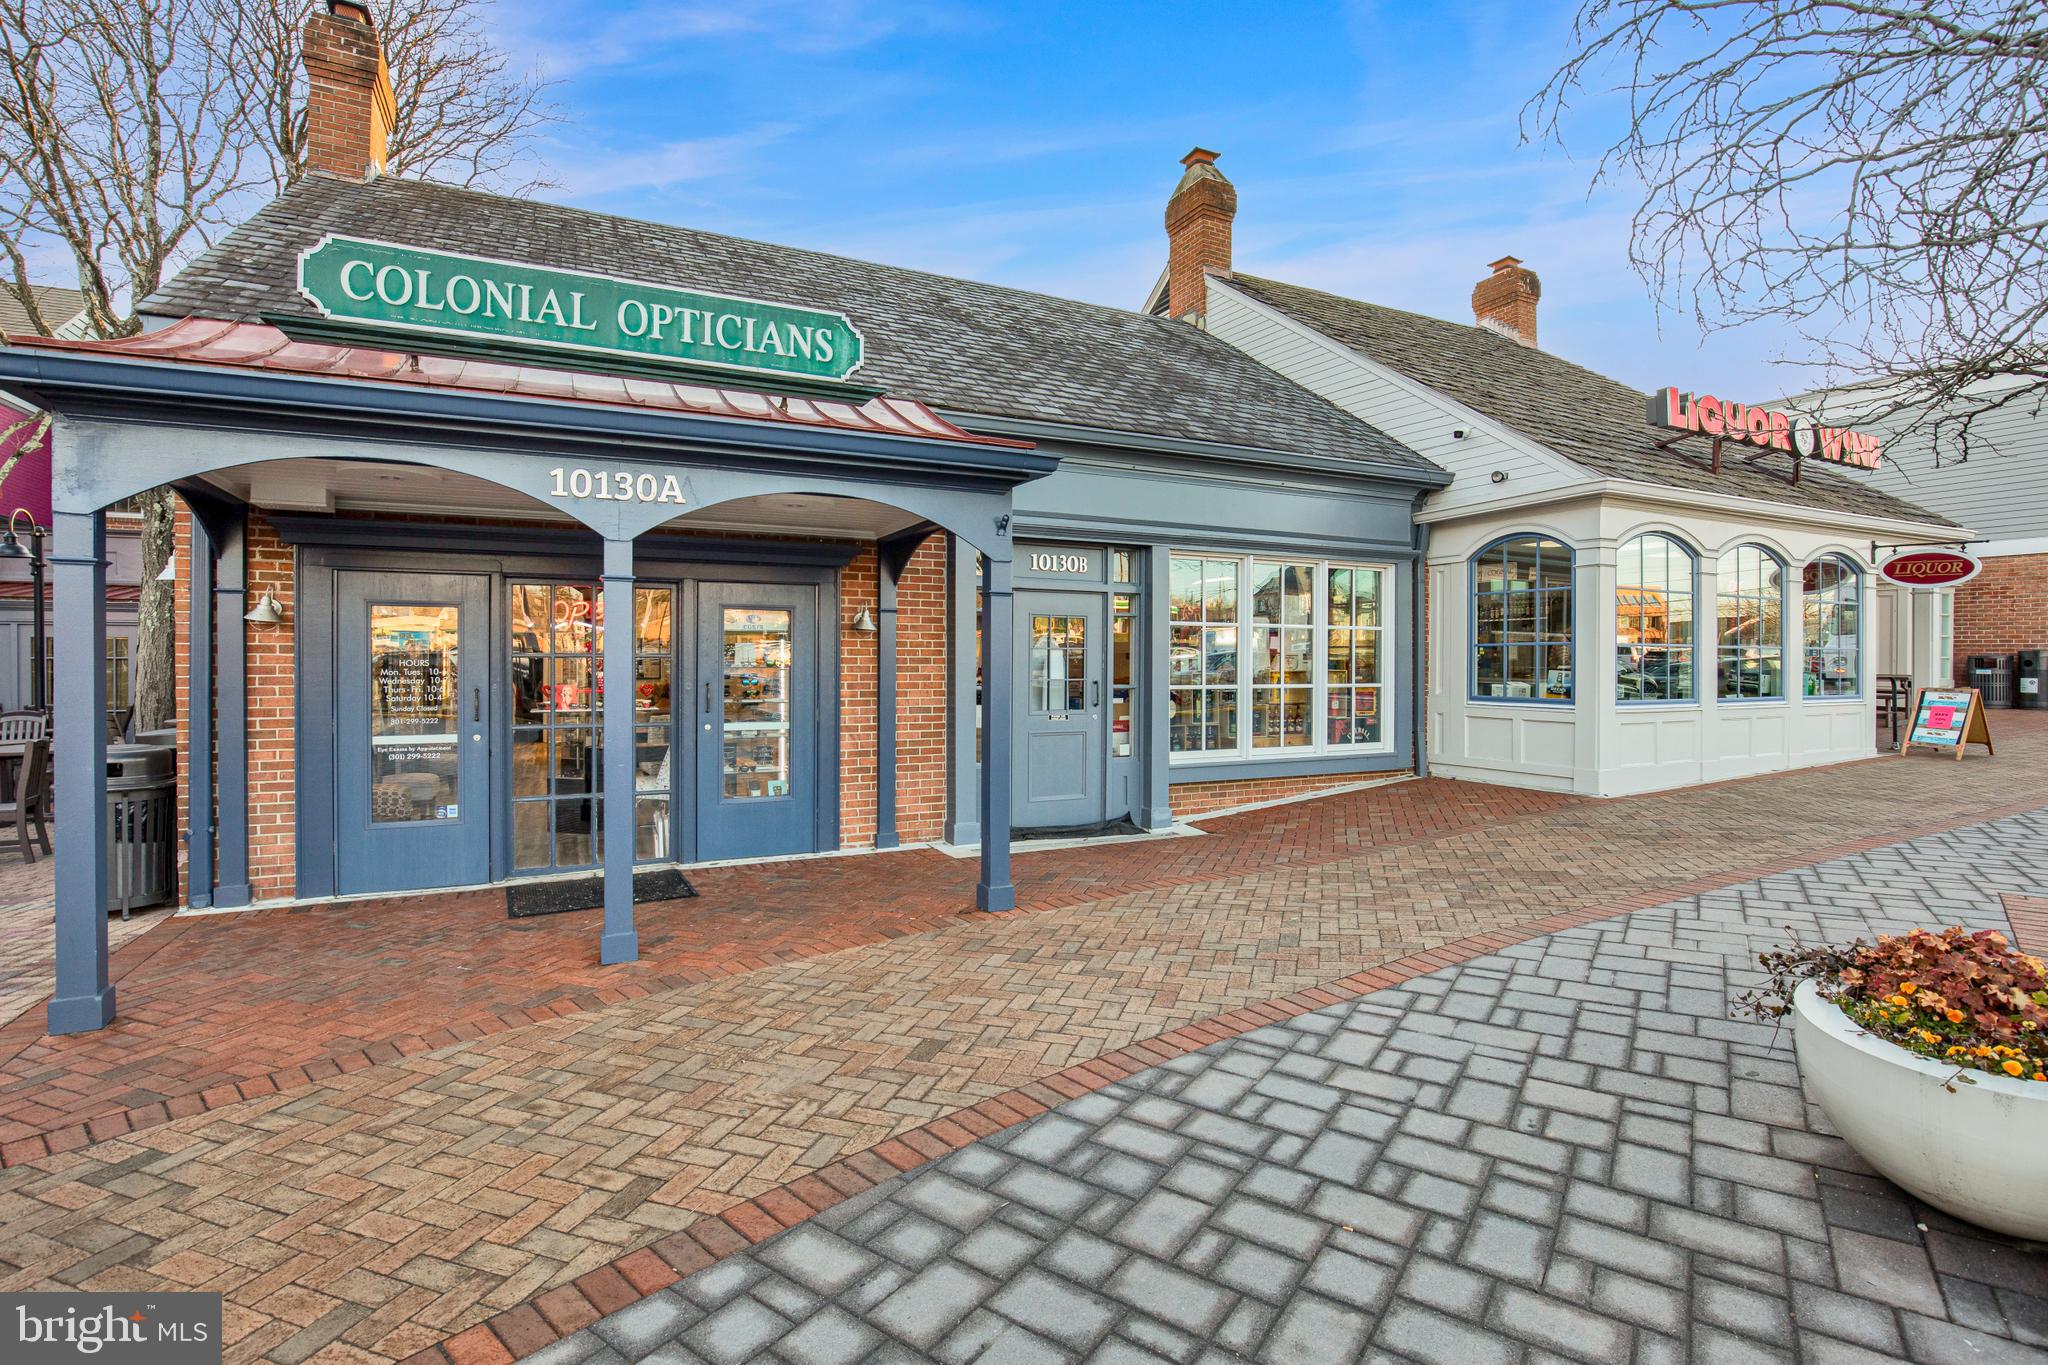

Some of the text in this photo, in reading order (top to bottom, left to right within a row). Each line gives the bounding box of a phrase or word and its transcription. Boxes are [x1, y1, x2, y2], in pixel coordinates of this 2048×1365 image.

[339, 260, 835, 363] COLONIAL OPTICIANS
[549, 467, 687, 504] 10130A
[1030, 553, 1088, 573] 10130B
[1895, 561, 1964, 578] LIQUOR
[554, 600, 604, 629] OPE
[379, 677, 425, 685] Wednesday
[404, 668, 423, 676] Tues.
